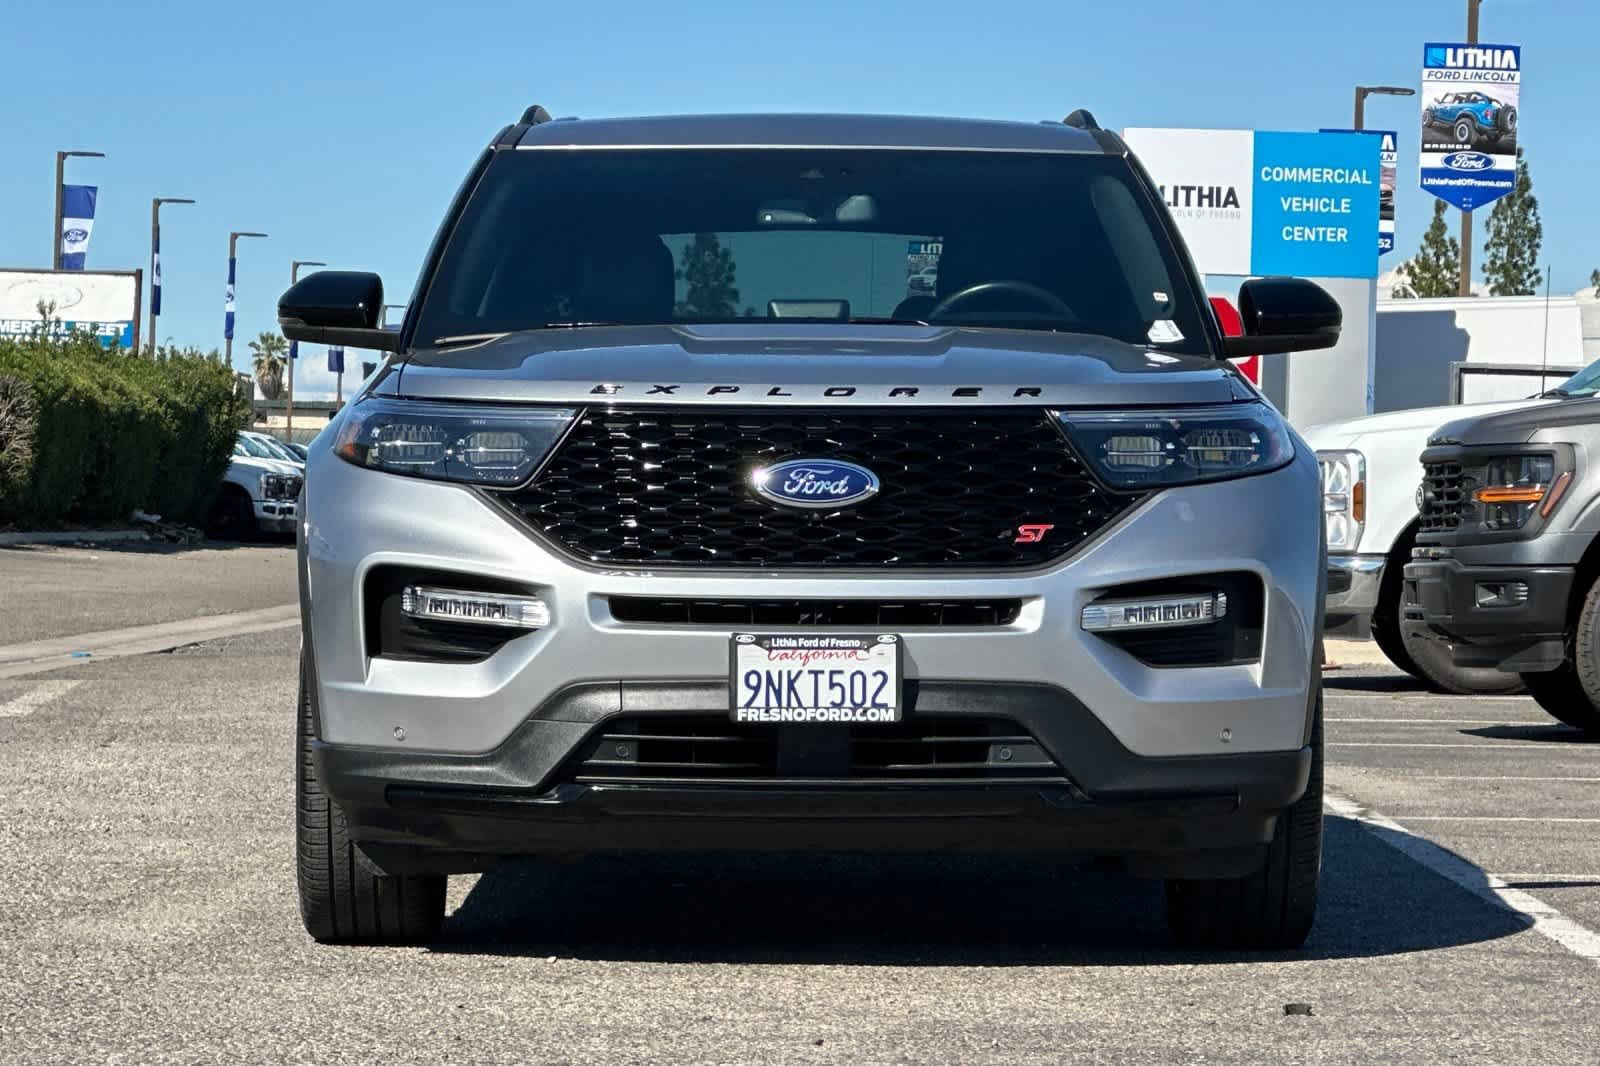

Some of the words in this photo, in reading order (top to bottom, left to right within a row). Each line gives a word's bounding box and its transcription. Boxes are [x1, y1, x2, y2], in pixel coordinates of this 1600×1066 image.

[1446, 48, 1517, 69] LITHIA
[1427, 70, 1461, 80] FORD
[1463, 71, 1516, 82] LINCOLN
[1451, 153, 1485, 169] Ford
[1261, 166, 1372, 184] COMMERCIAL
[1280, 196, 1352, 213] VEHICLE
[1282, 226, 1349, 242] CENTER
[589, 384, 1042, 397] EXPLORER
[783, 467, 850, 494] Ford
[1014, 524, 1055, 543] ST
[771, 637, 798, 648] Lithia
[799, 637, 819, 648] Ford
[820, 638, 830, 648] of
[831, 638, 861, 648] Fresno
[743, 669, 889, 709] 9NKT502
[737, 708, 895, 721] FRESNOFORD.COM
